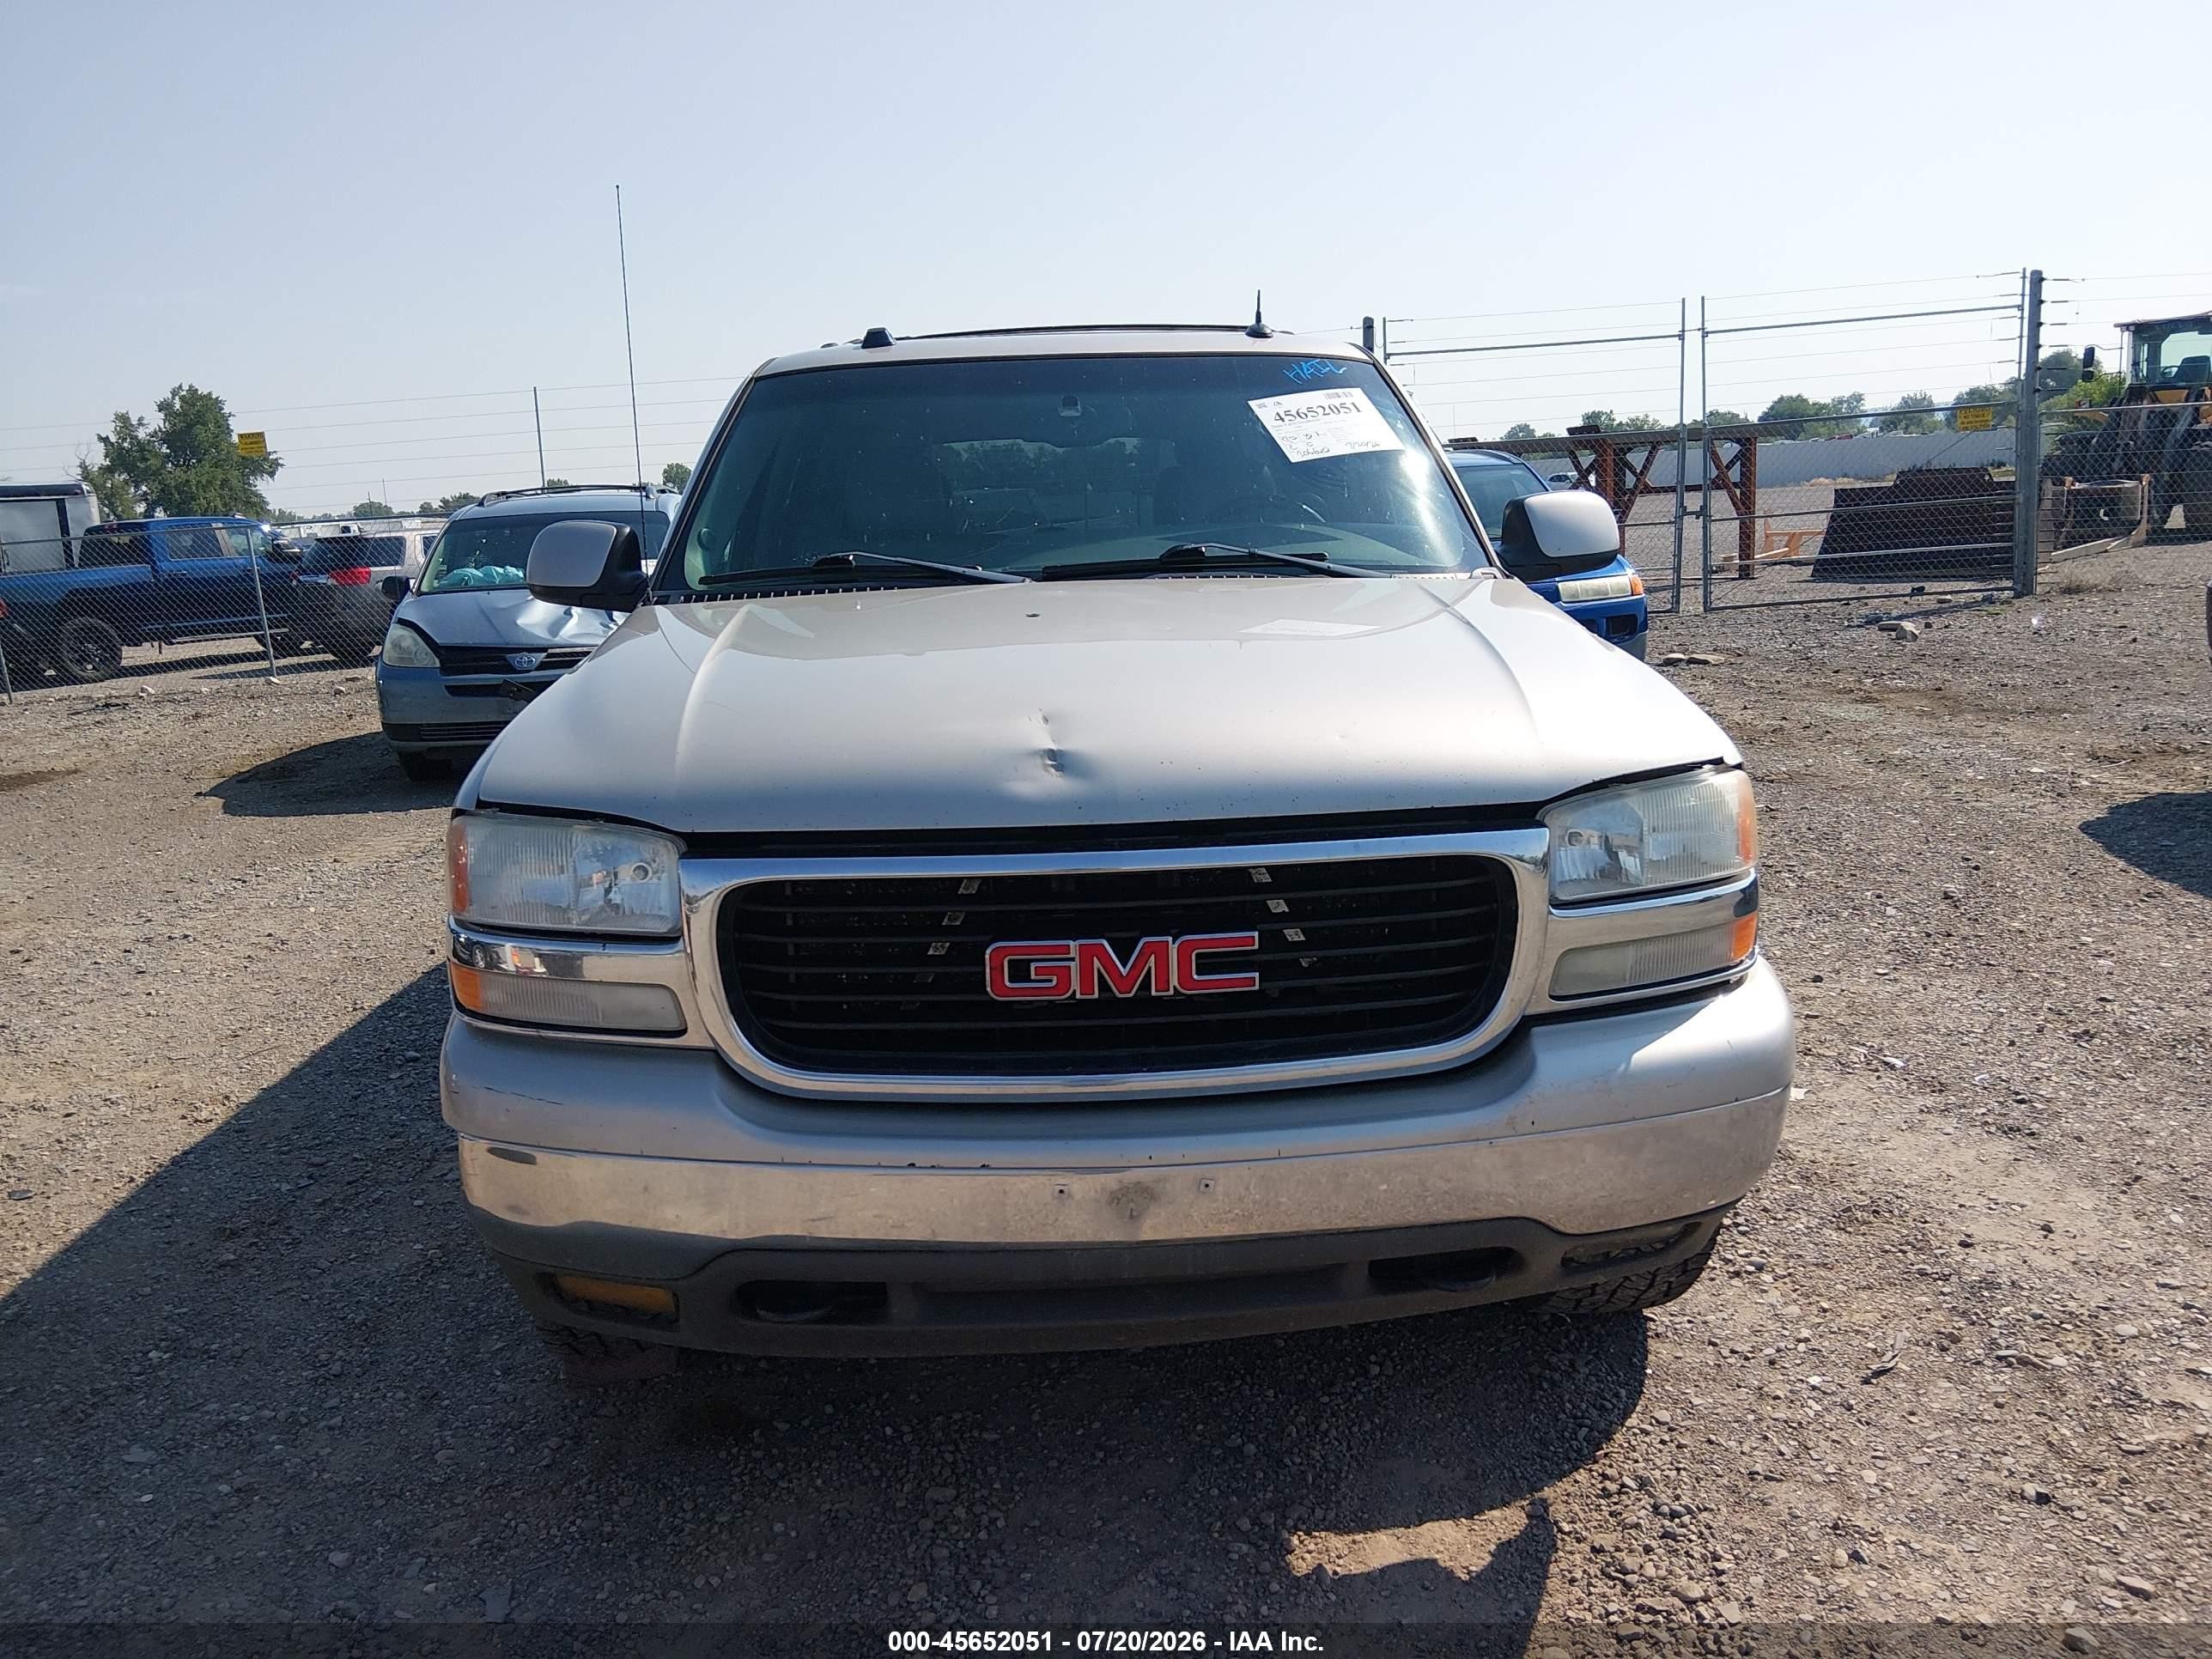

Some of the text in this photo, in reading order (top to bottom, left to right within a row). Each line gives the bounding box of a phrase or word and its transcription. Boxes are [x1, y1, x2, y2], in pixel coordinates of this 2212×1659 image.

[1283, 359, 1347, 385] HAIL
[1274, 402, 1362, 422] 45652051
[985, 931, 1260, 1001] GMC
